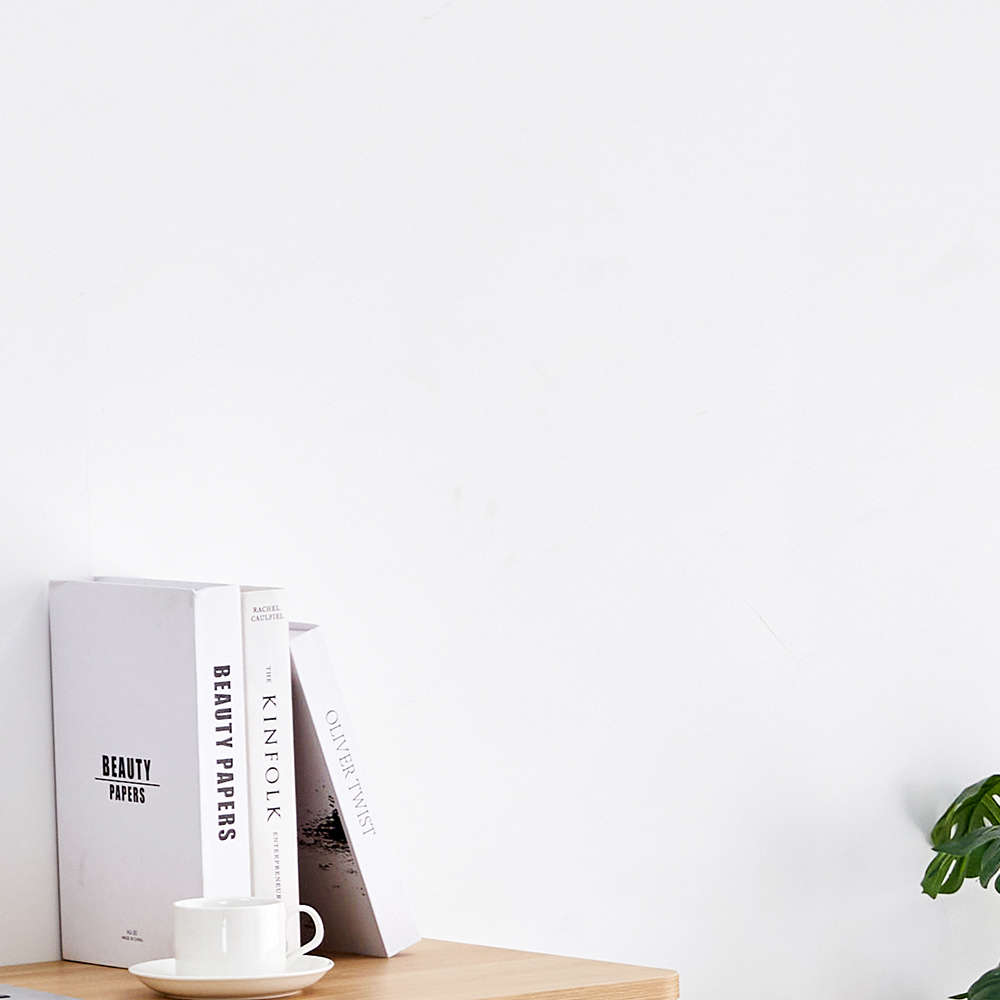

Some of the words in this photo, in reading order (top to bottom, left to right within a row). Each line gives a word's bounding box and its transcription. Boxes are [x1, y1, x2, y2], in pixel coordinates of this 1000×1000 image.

[253, 605, 280, 613] RACHEL
[213, 665, 233, 748] BEAUTY
[102, 754, 151, 781] BEAUTY
[109, 784, 146, 804] PAPERS
[216, 758, 236, 841] PAPERS
[262, 694, 282, 822] KINFOLK
[325, 709, 356, 779] OLIVER
[348, 778, 376, 836] TWIST
